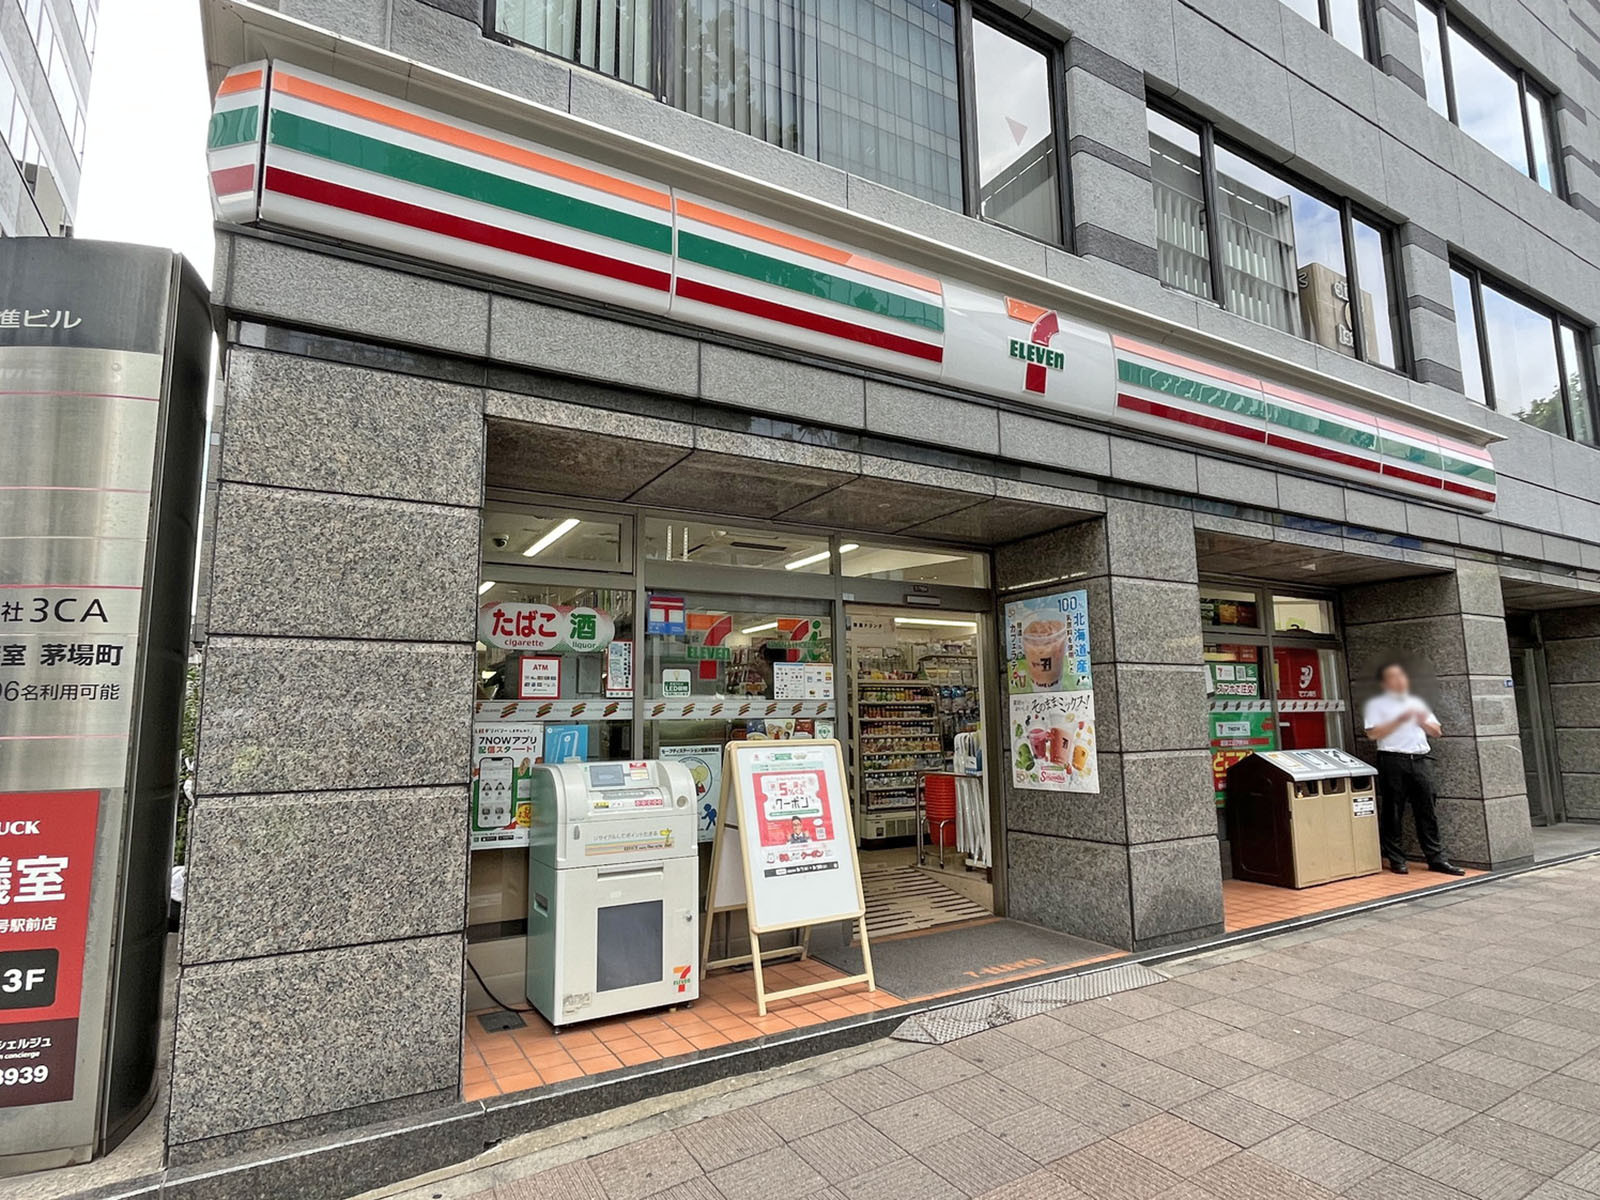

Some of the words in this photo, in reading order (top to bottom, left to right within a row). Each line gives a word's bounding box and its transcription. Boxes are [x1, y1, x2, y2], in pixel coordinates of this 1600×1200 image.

[492, 608, 557, 637] たばこ
[570, 612, 597, 640] 酒
[504, 639, 545, 648] cigarette
[572, 641, 597, 650] liquor
[1074, 612, 1088, 673] 北海道産
[0, 643, 26, 666] 室
[40, 643, 123, 666] 茅場町
[532, 663, 549, 672] ATM
[0, 681, 120, 701] 6名利用可能
[479, 736, 537, 745] 7NOWアプリ
[0, 854, 69, 905] 室
[2, 968, 46, 992] 3F
